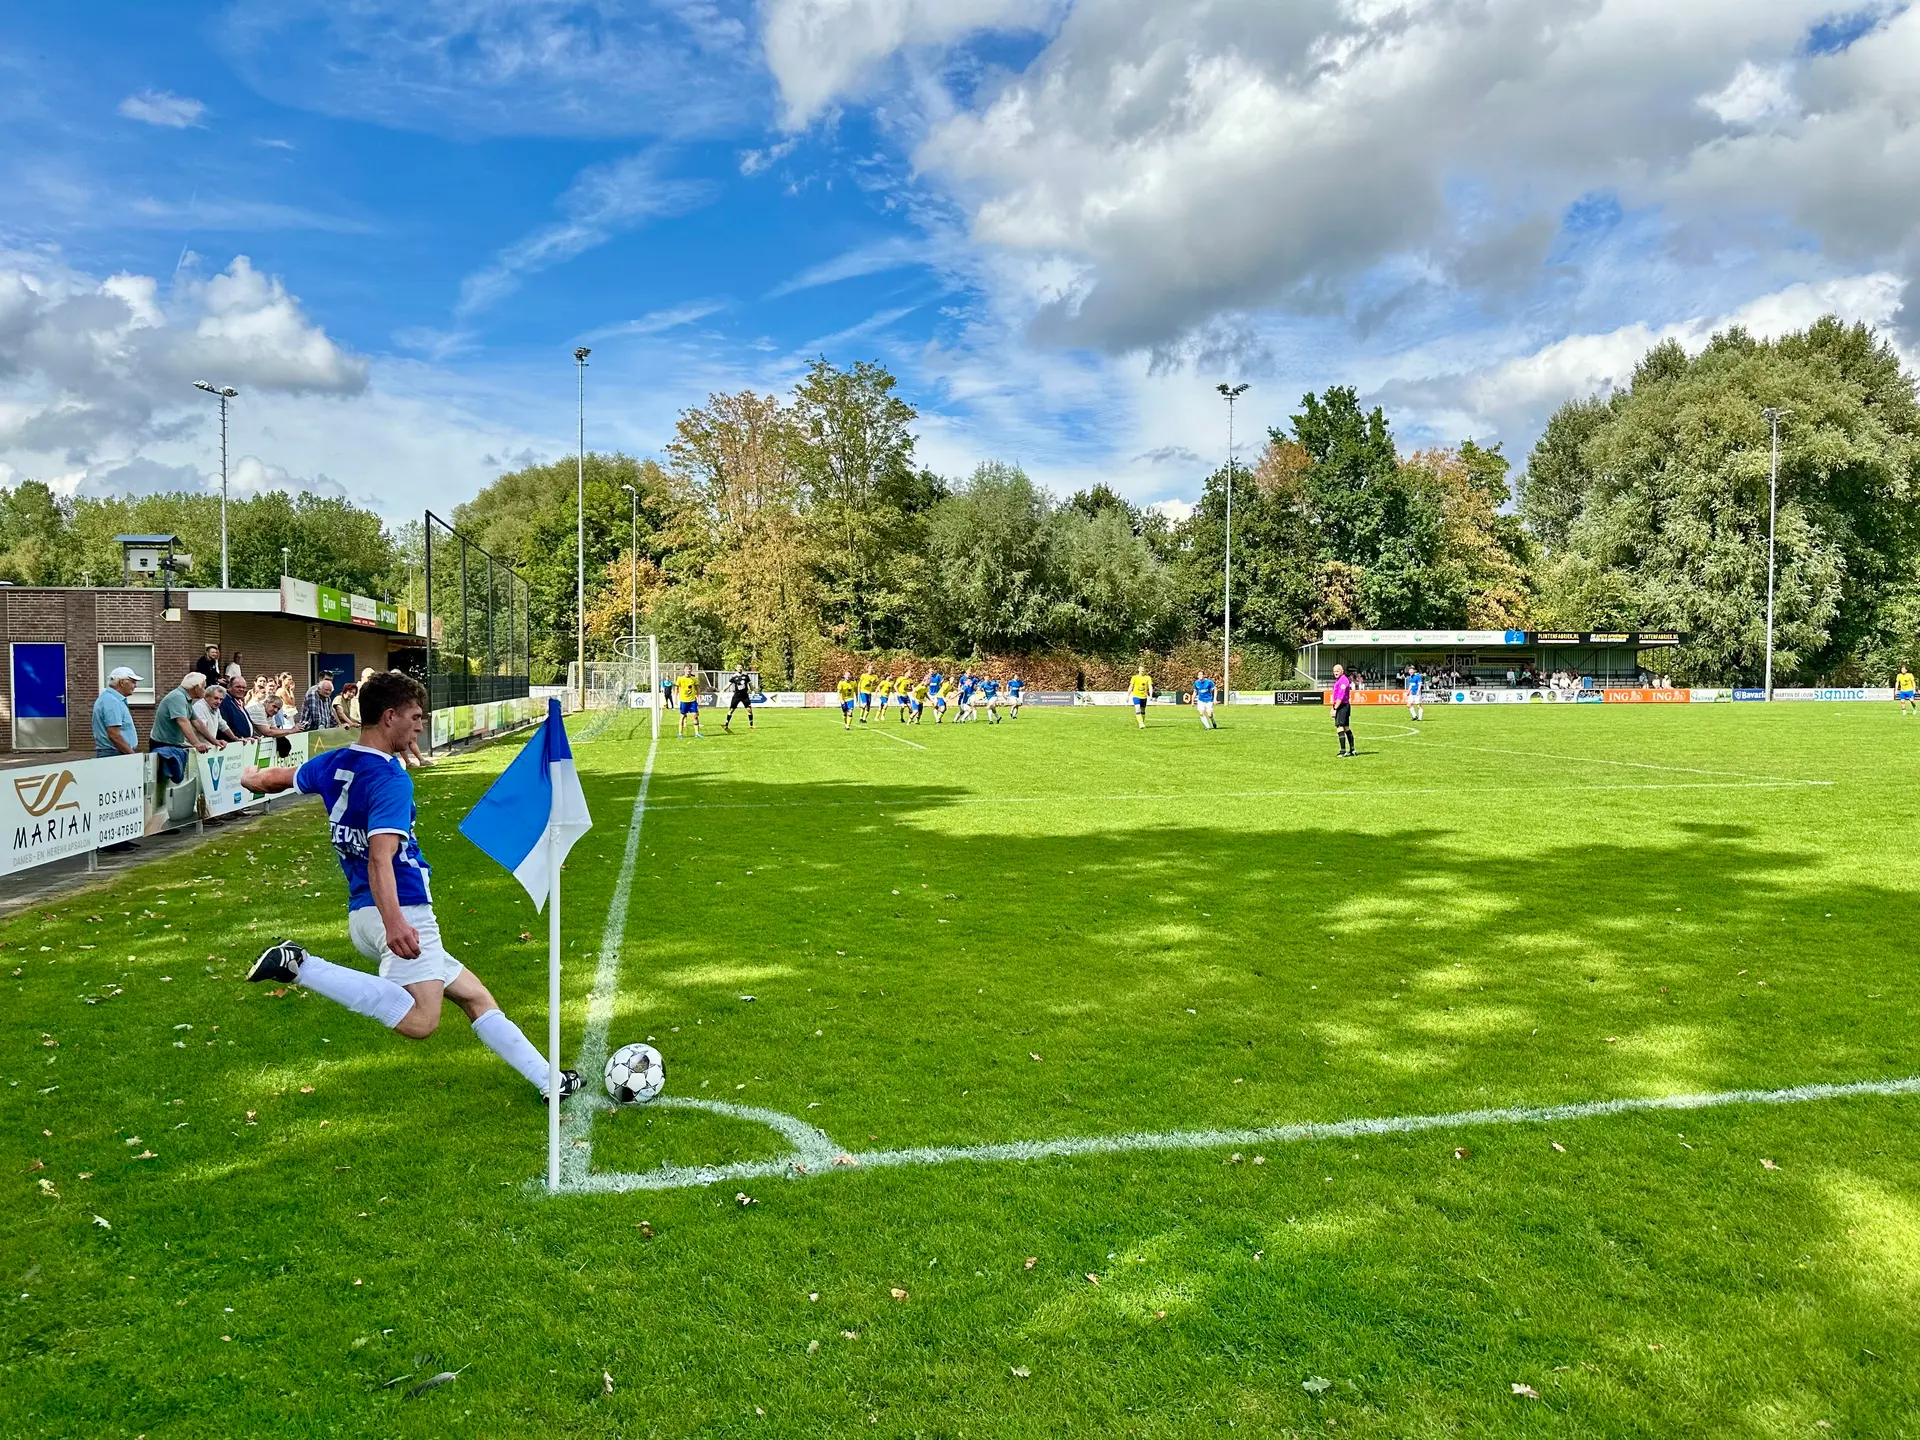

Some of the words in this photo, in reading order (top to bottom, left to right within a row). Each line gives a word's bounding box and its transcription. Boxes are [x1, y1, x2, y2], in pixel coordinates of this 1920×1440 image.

[1277, 692, 1299, 702] BLUSH
[1378, 693, 1400, 703] ING
[1608, 692, 1629, 701] ING
[1652, 692, 1672, 701] ING
[98, 786, 142, 807] BOSKANT
[329, 768, 355, 823] 7
[99, 808, 139, 823] POPULIERENLAAN
[13, 812, 92, 850] MARIAN
[99, 821, 142, 843] 0413-476907
[46, 838, 92, 857] HERENKAPSALON
